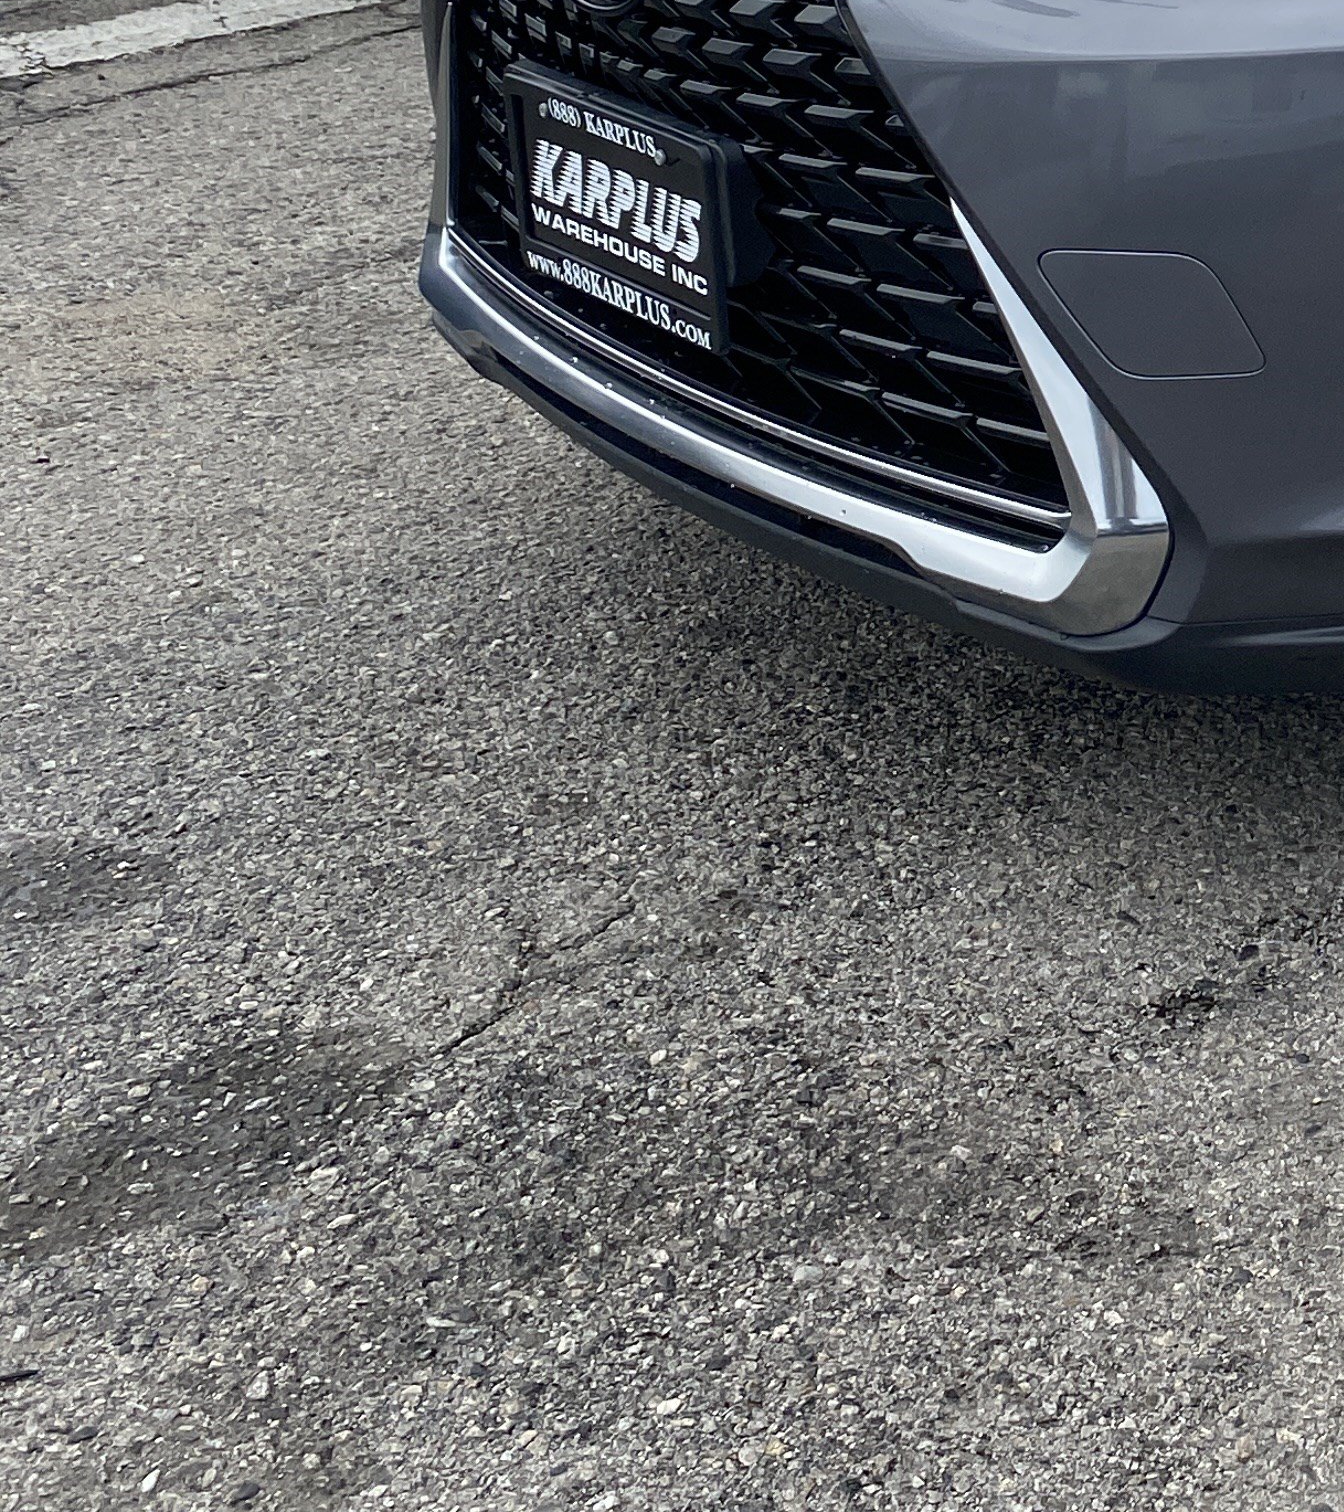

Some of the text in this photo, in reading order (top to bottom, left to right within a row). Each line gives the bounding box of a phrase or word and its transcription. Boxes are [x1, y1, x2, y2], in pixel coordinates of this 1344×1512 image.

[547, 97, 657, 157] (888) KARPLUS
[529, 139, 702, 263] KARPLUS
[531, 203, 709, 296] WAREHOUSE INC
